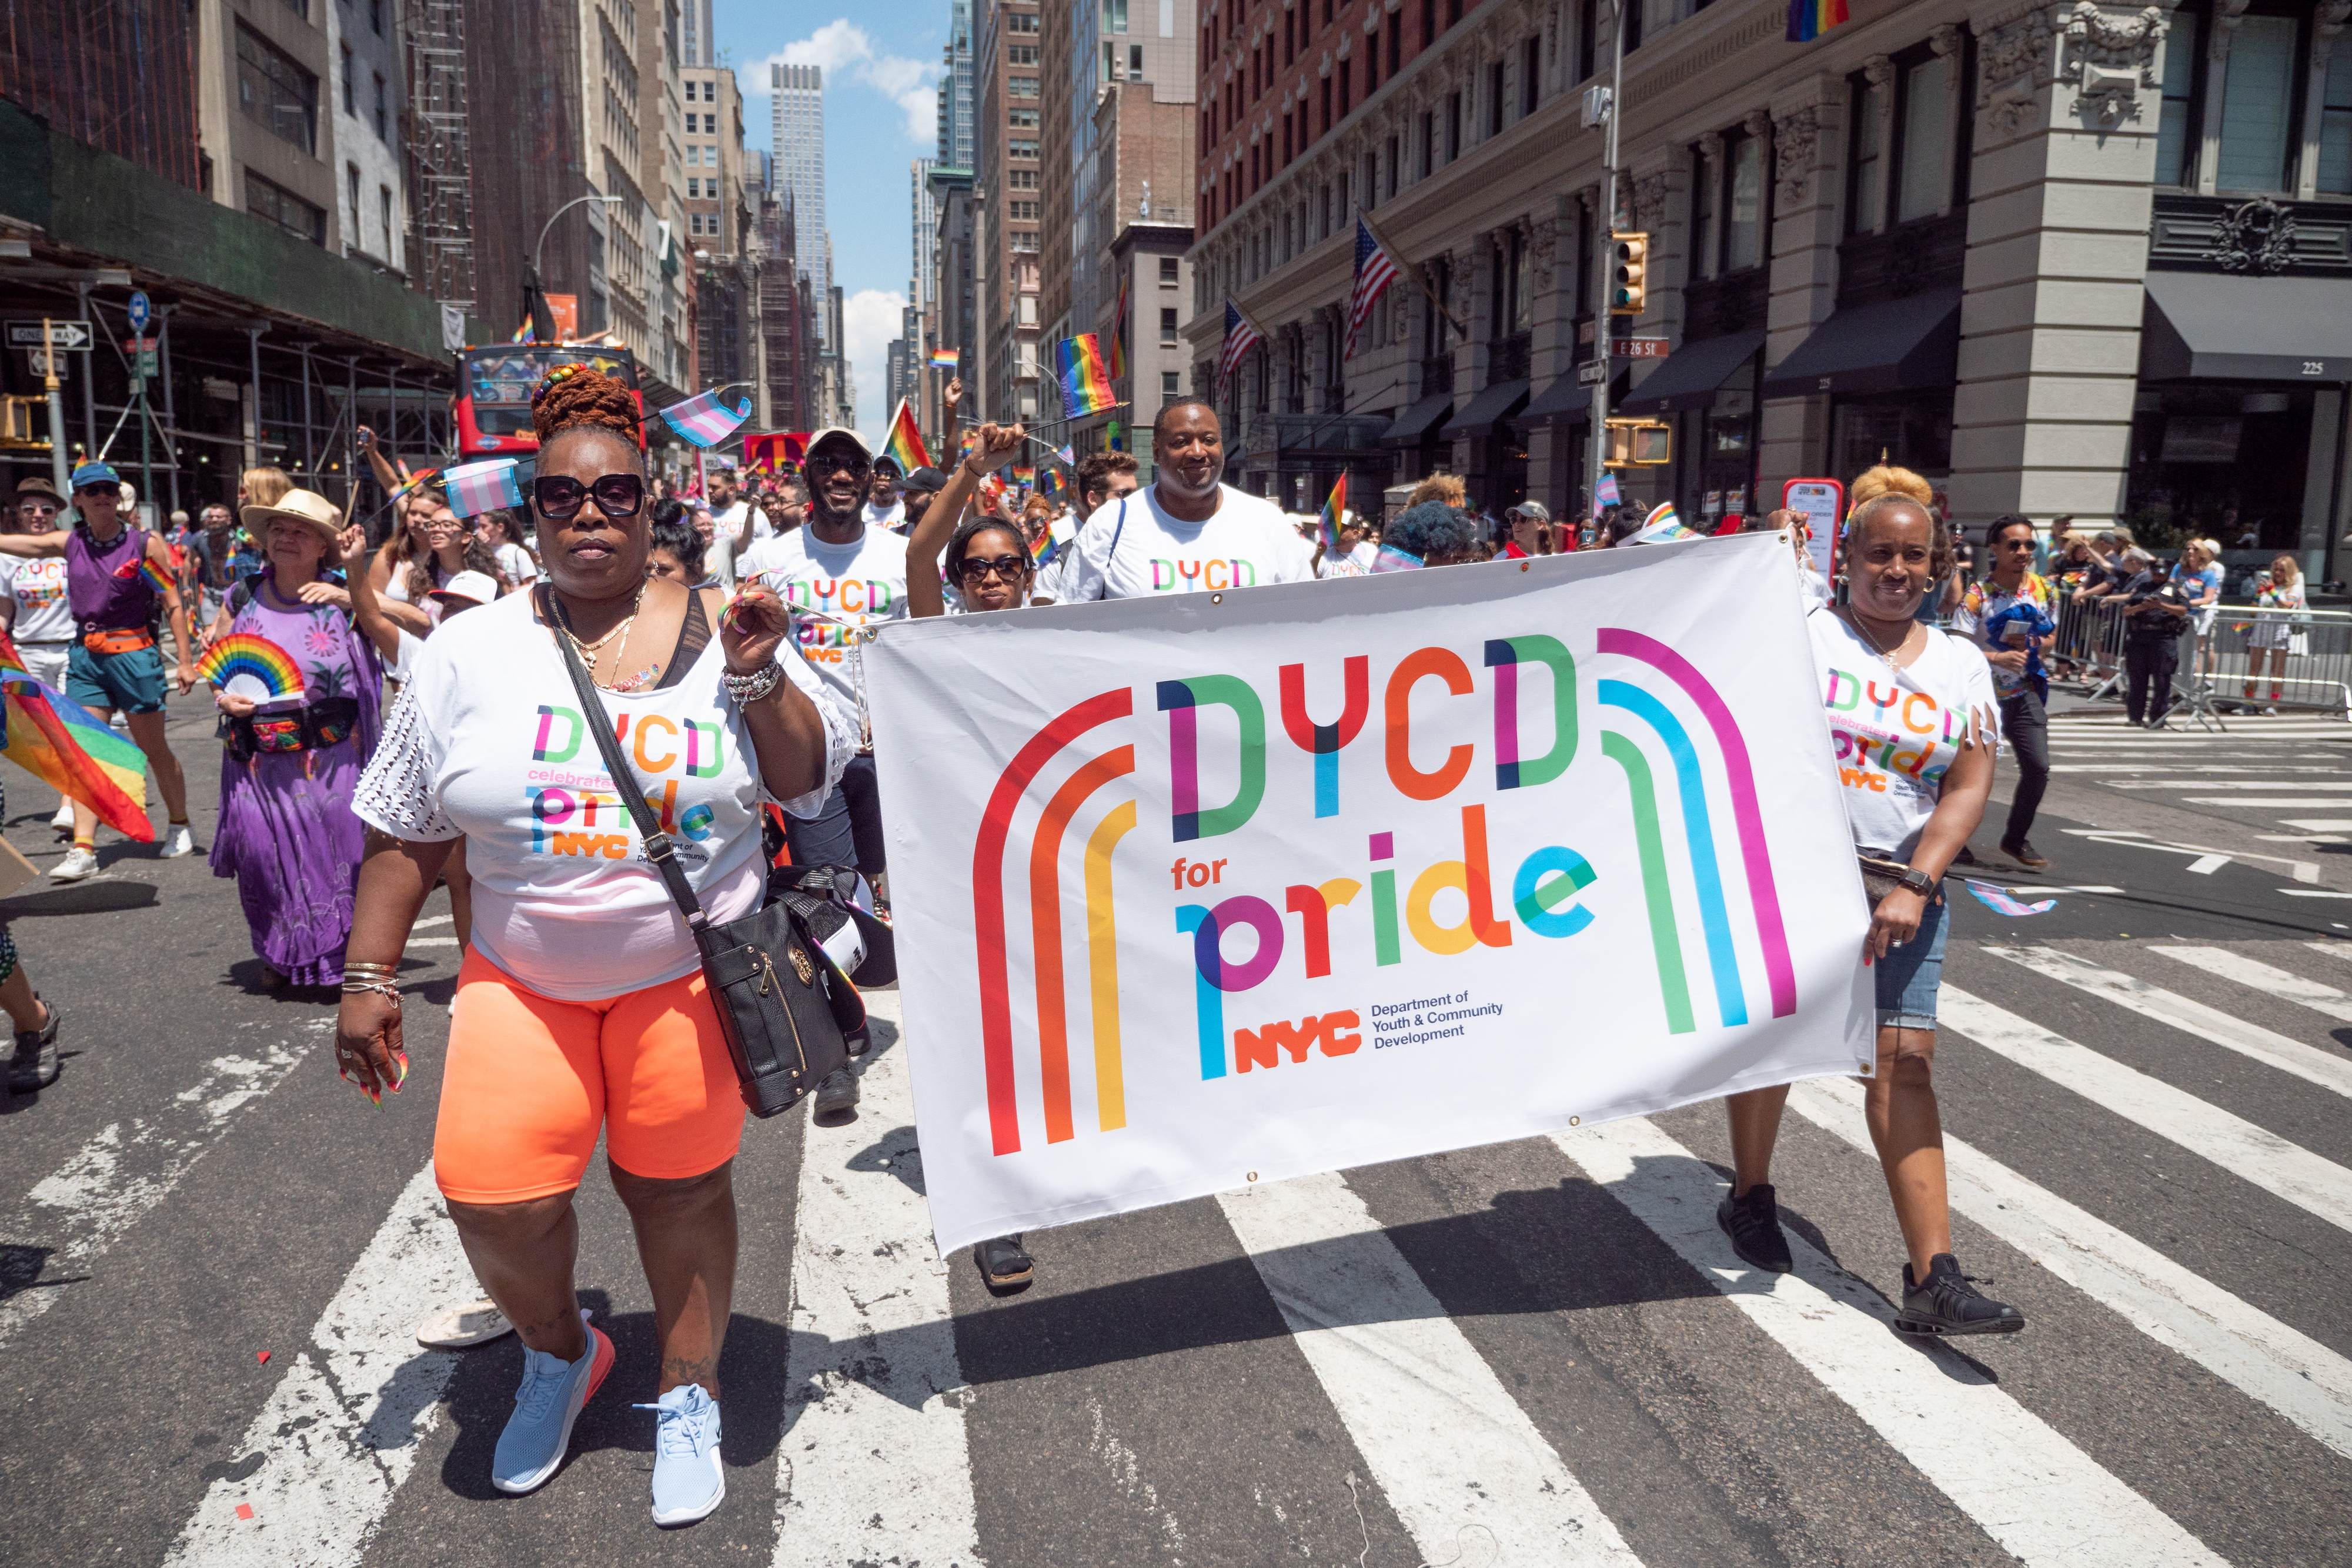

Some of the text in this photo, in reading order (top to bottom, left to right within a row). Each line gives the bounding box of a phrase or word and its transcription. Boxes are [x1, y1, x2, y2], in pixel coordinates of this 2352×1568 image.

[1621, 342, 1656, 355] E 26 St
[2301, 361, 2324, 375] 225
[713, 520, 744, 533] YC
[1149, 559, 1255, 592] DYCD
[787, 579, 891, 614] DYCD
[804, 647, 843, 663] NYC
[1825, 667, 1967, 748] DYCD
[1156, 634, 1579, 843] DYCD
[1828, 714, 1888, 737] elebrates
[528, 767, 619, 791] celebrates
[553, 831, 630, 860] NYC
[673, 852, 709, 862] ommunity
[1171, 857, 1228, 891] for
[1175, 803, 1598, 1082] pride
[1371, 989, 1469, 1017] Department of
[1372, 1003, 1504, 1032] Youth & Community
[1233, 1009, 1362, 1075] NYC
[1374, 1024, 1465, 1049] Development
